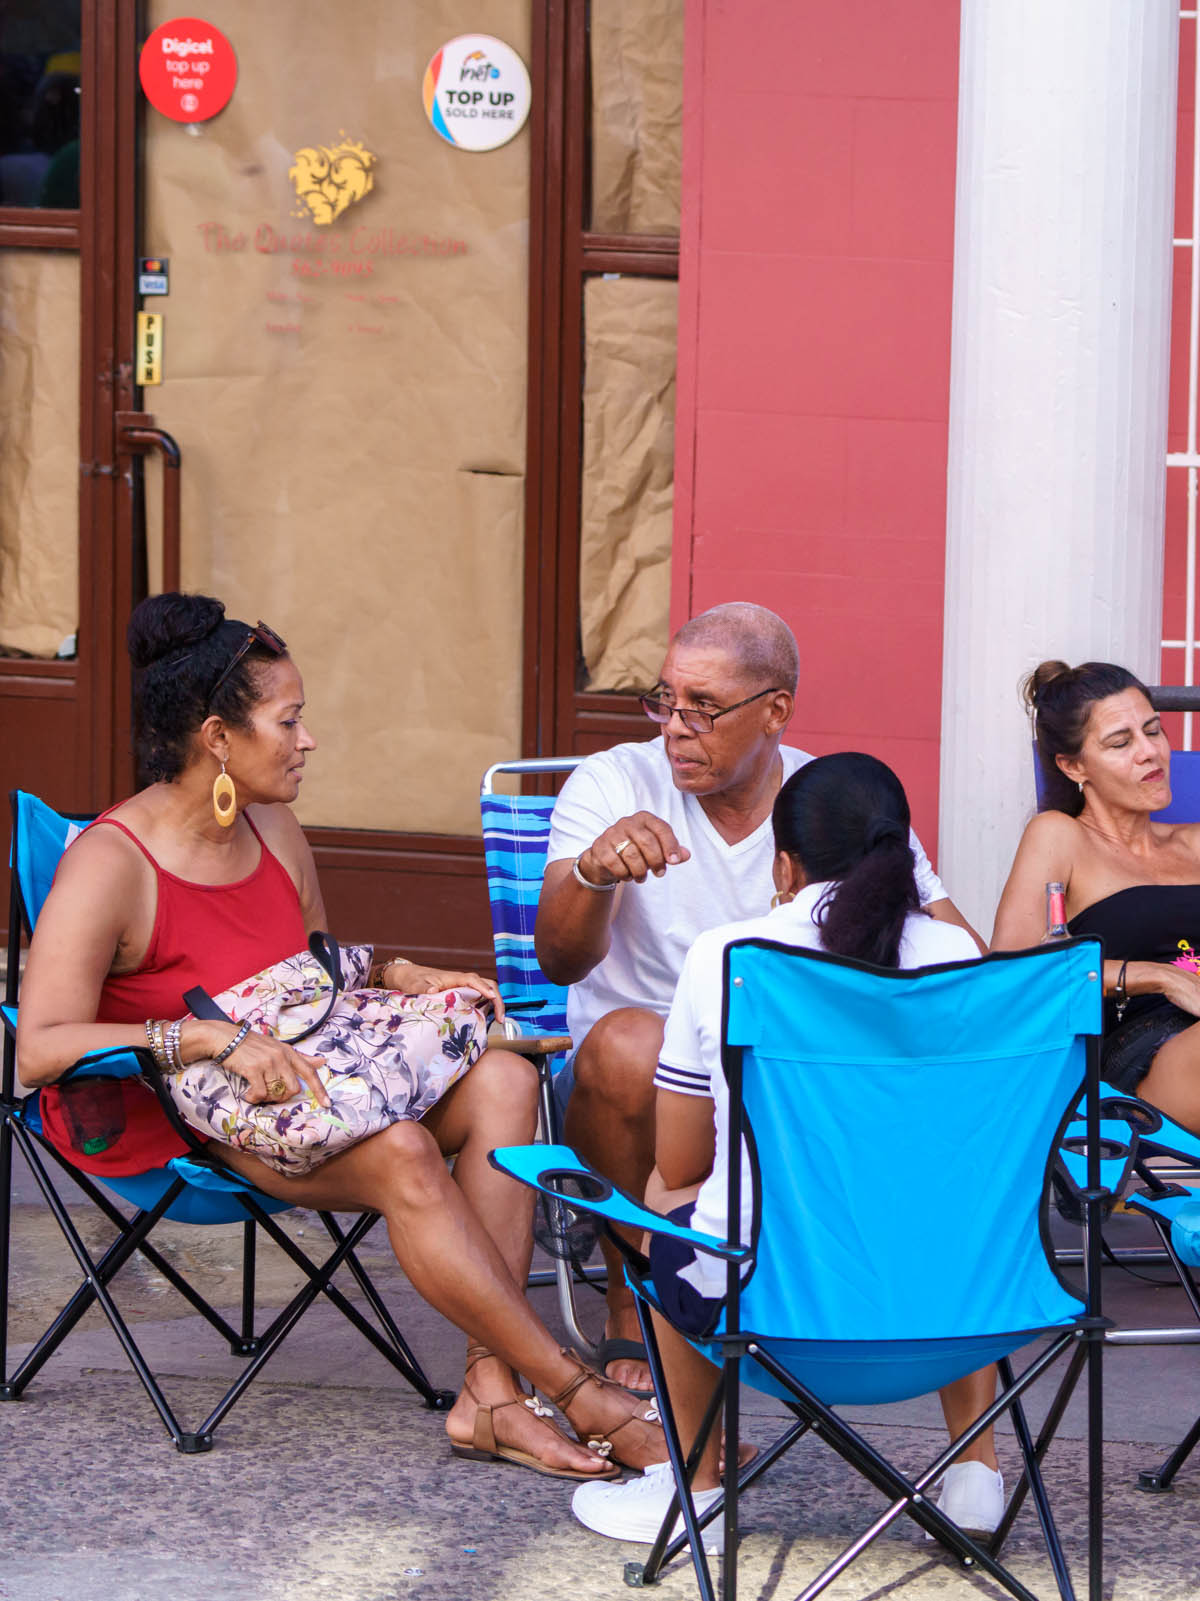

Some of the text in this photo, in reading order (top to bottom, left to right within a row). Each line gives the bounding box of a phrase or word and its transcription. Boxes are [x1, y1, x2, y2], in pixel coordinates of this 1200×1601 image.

[161, 37, 214, 57] Digicel
[166, 59, 211, 75] top up
[172, 76, 204, 90] here
[446, 90, 515, 106] TOP UP
[445, 107, 515, 120] SOLD HERE
[145, 315, 155, 381] PUSH
